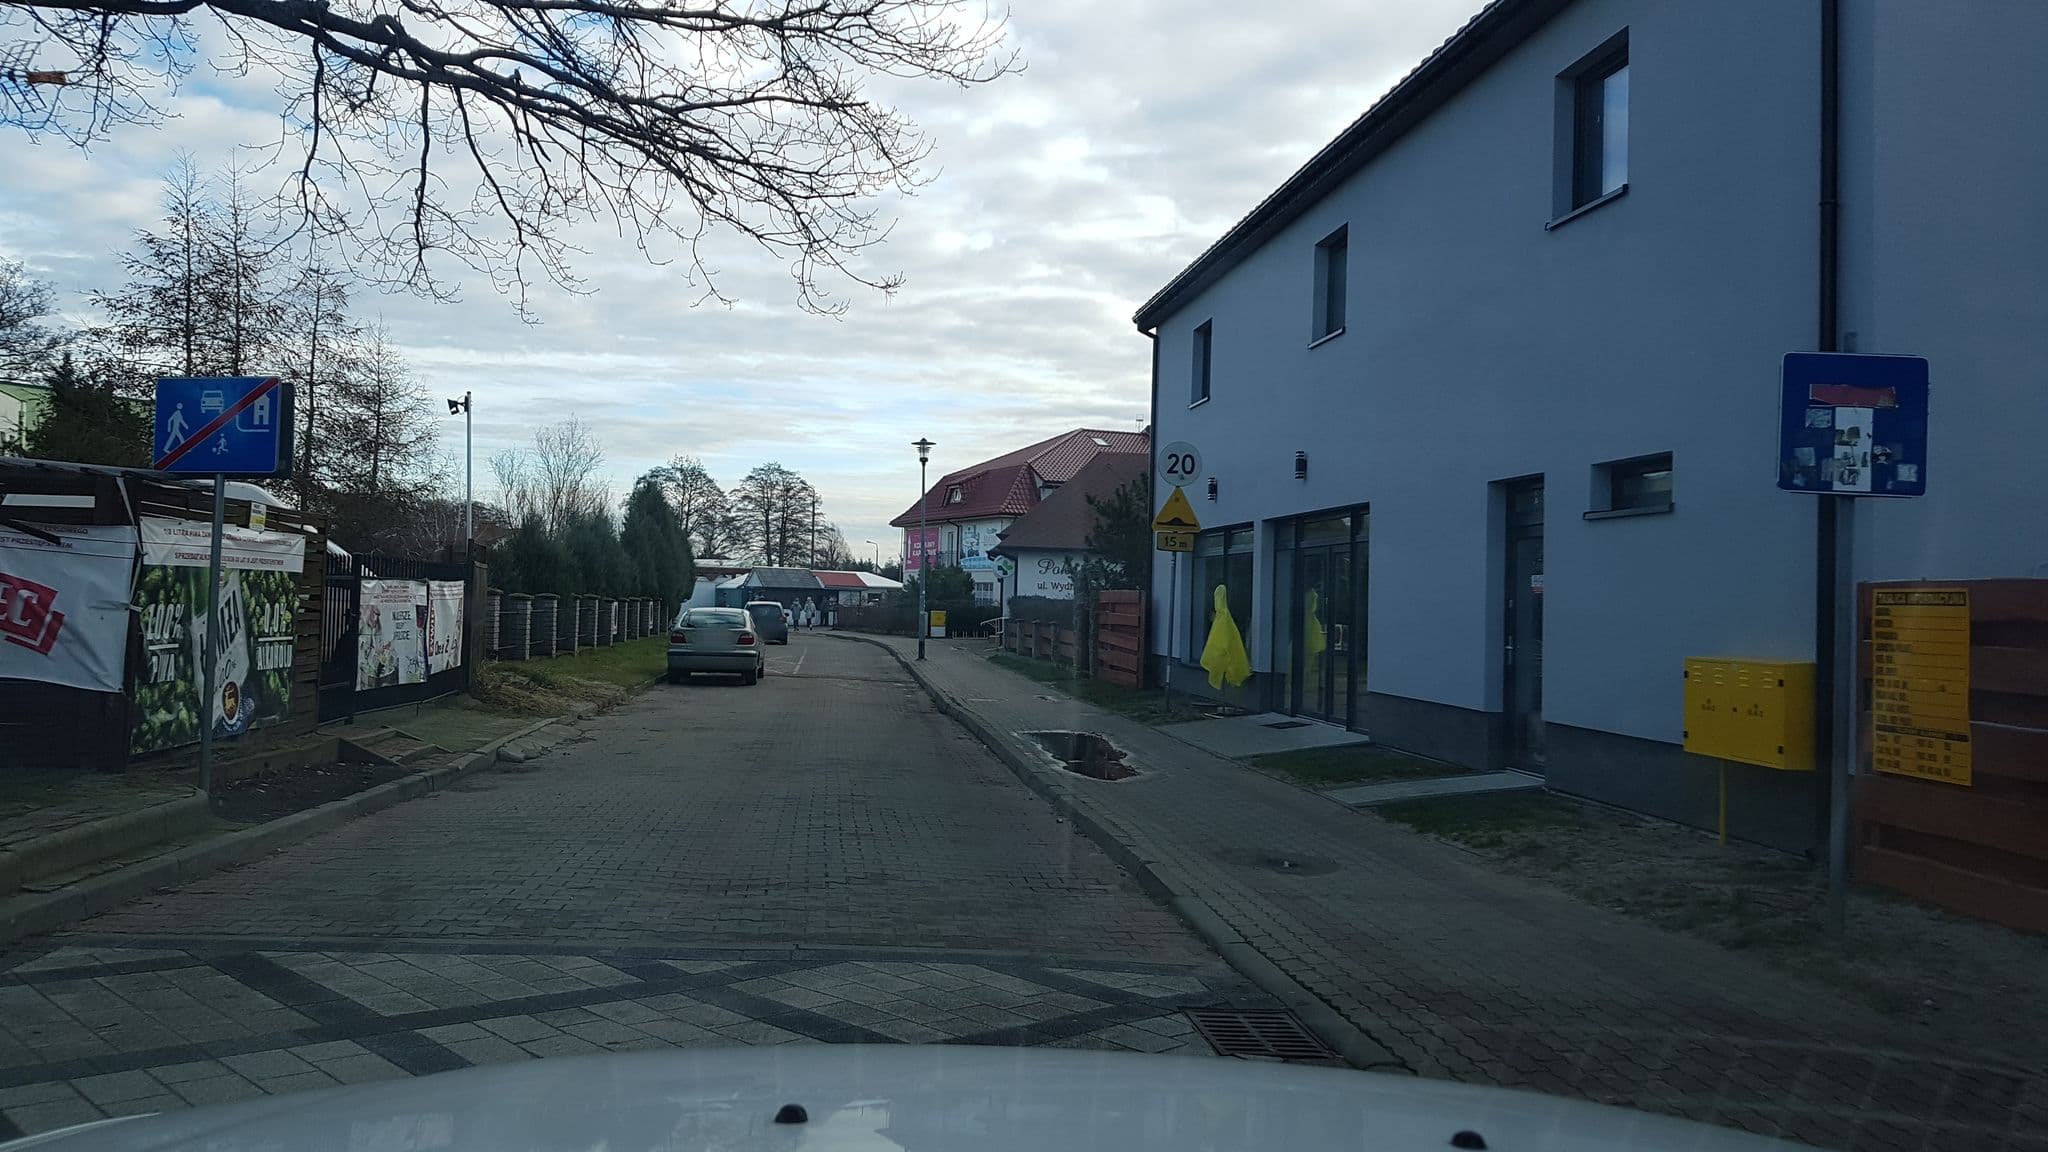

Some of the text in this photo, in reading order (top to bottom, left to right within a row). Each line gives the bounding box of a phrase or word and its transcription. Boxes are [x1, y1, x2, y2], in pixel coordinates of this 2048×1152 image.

[1167, 453, 1195, 475] 20
[1164, 536, 1177, 547] 15
[145, 603, 185, 640] 100%
